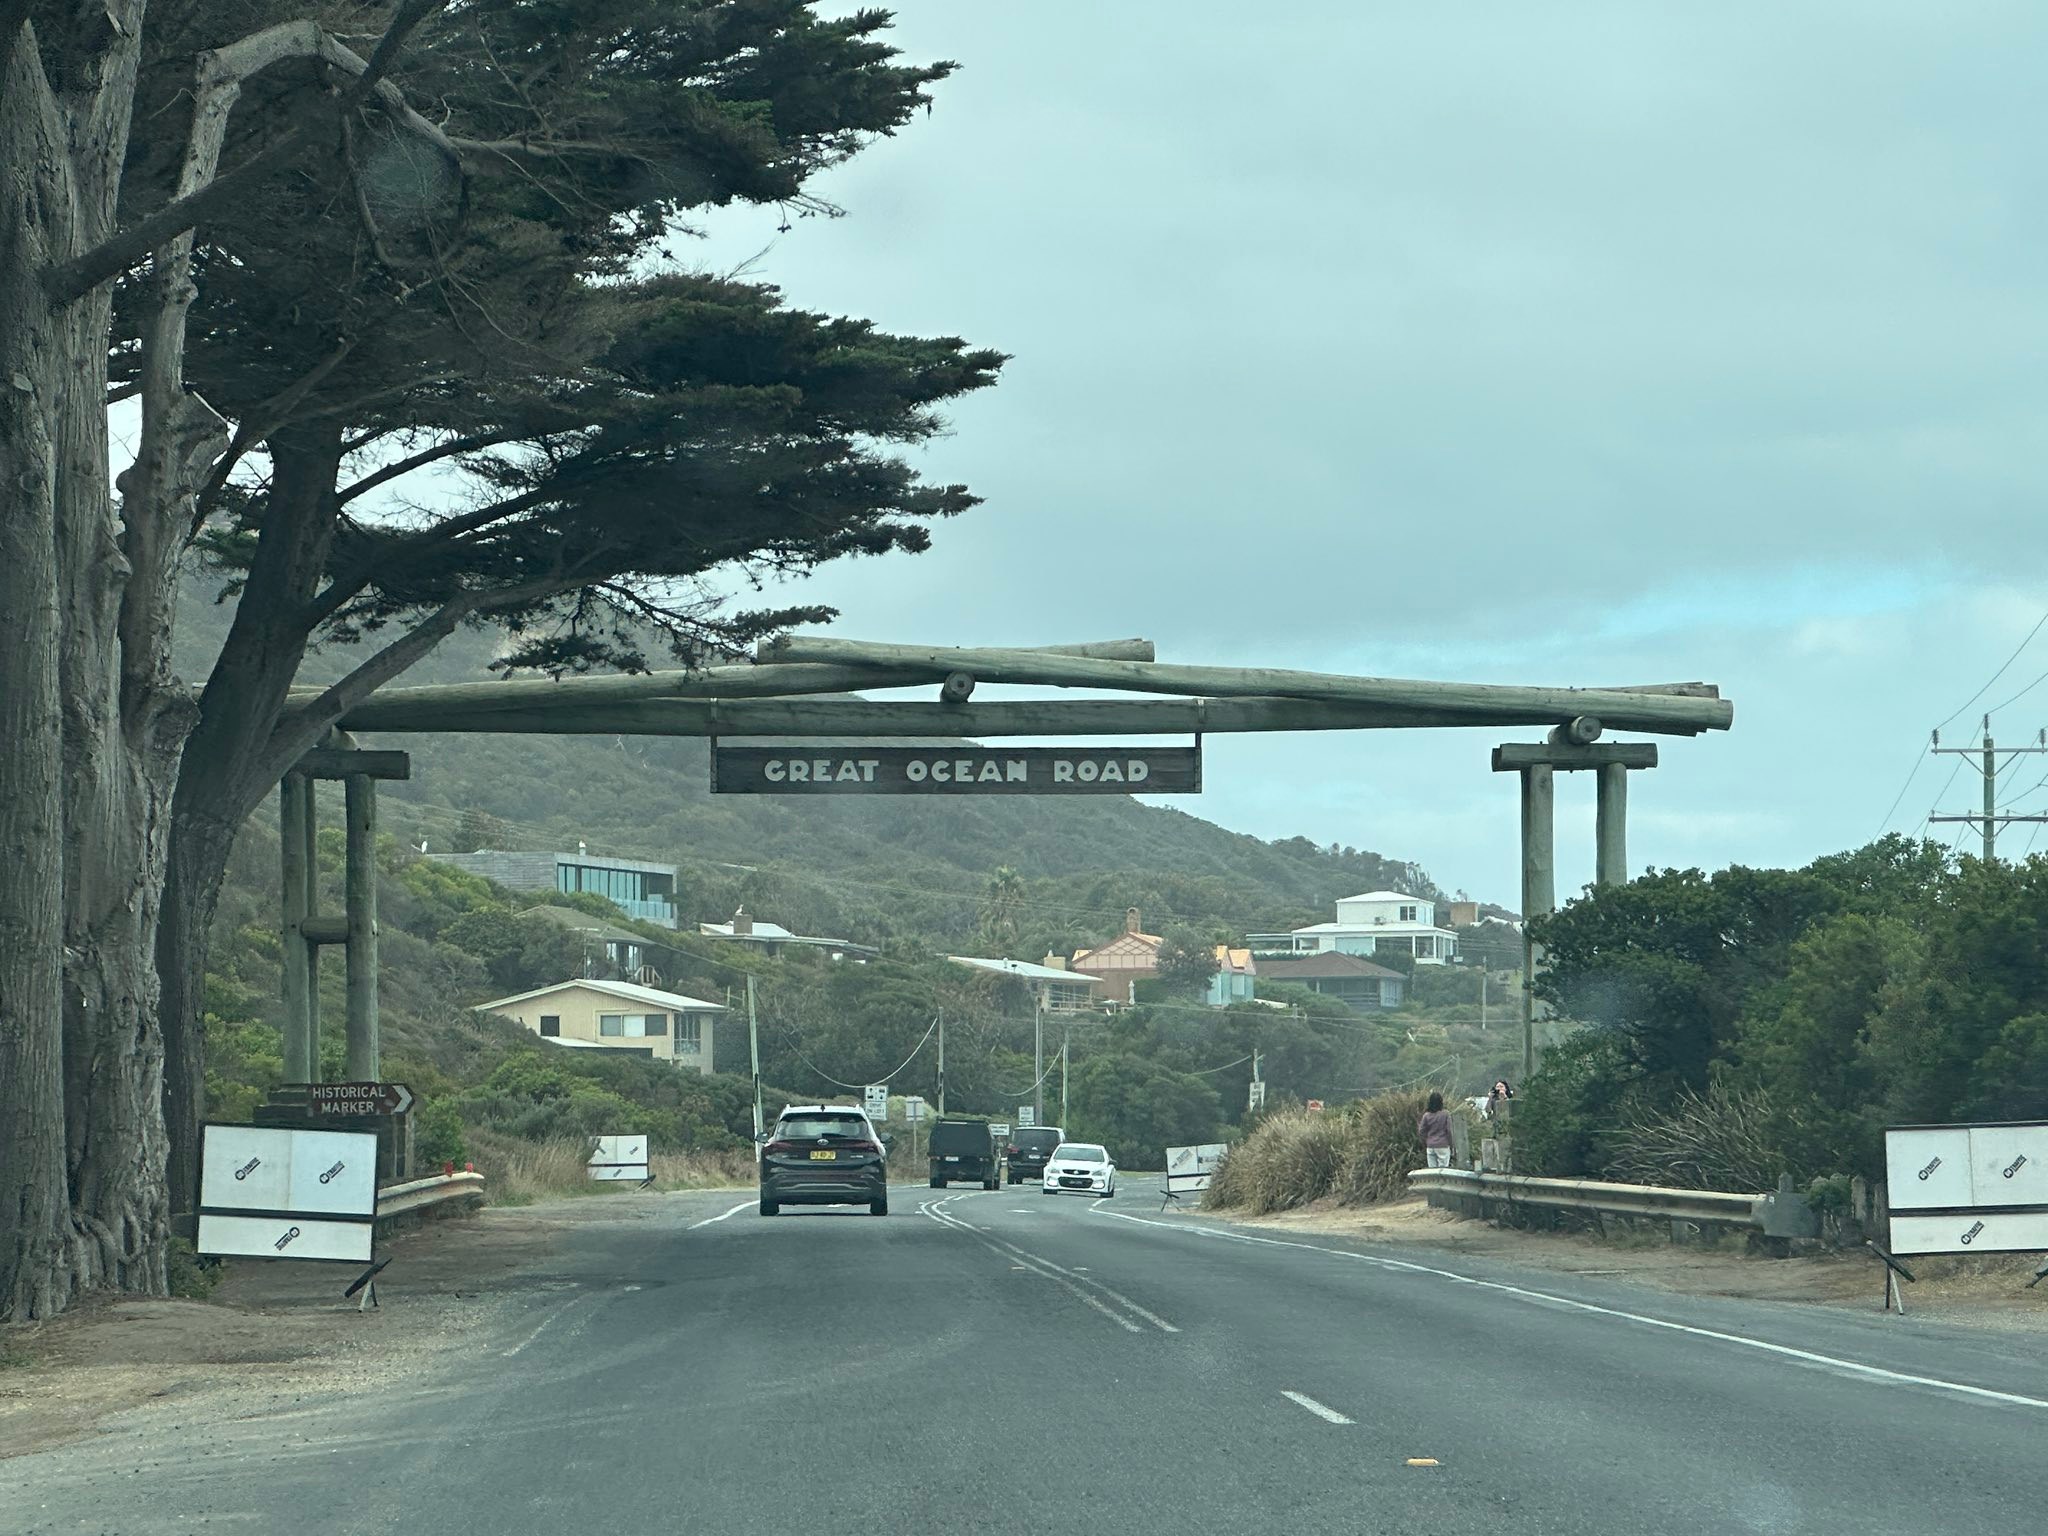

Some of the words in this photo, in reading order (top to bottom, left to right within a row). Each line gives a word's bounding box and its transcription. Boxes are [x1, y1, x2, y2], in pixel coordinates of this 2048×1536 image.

[764, 759, 880, 783] GREAT
[906, 759, 1027, 783] OCEAN
[1053, 759, 1149, 783] ROAD
[312, 1086, 386, 1099] HISTORICAL
[321, 1101, 374, 1113] MARKER
